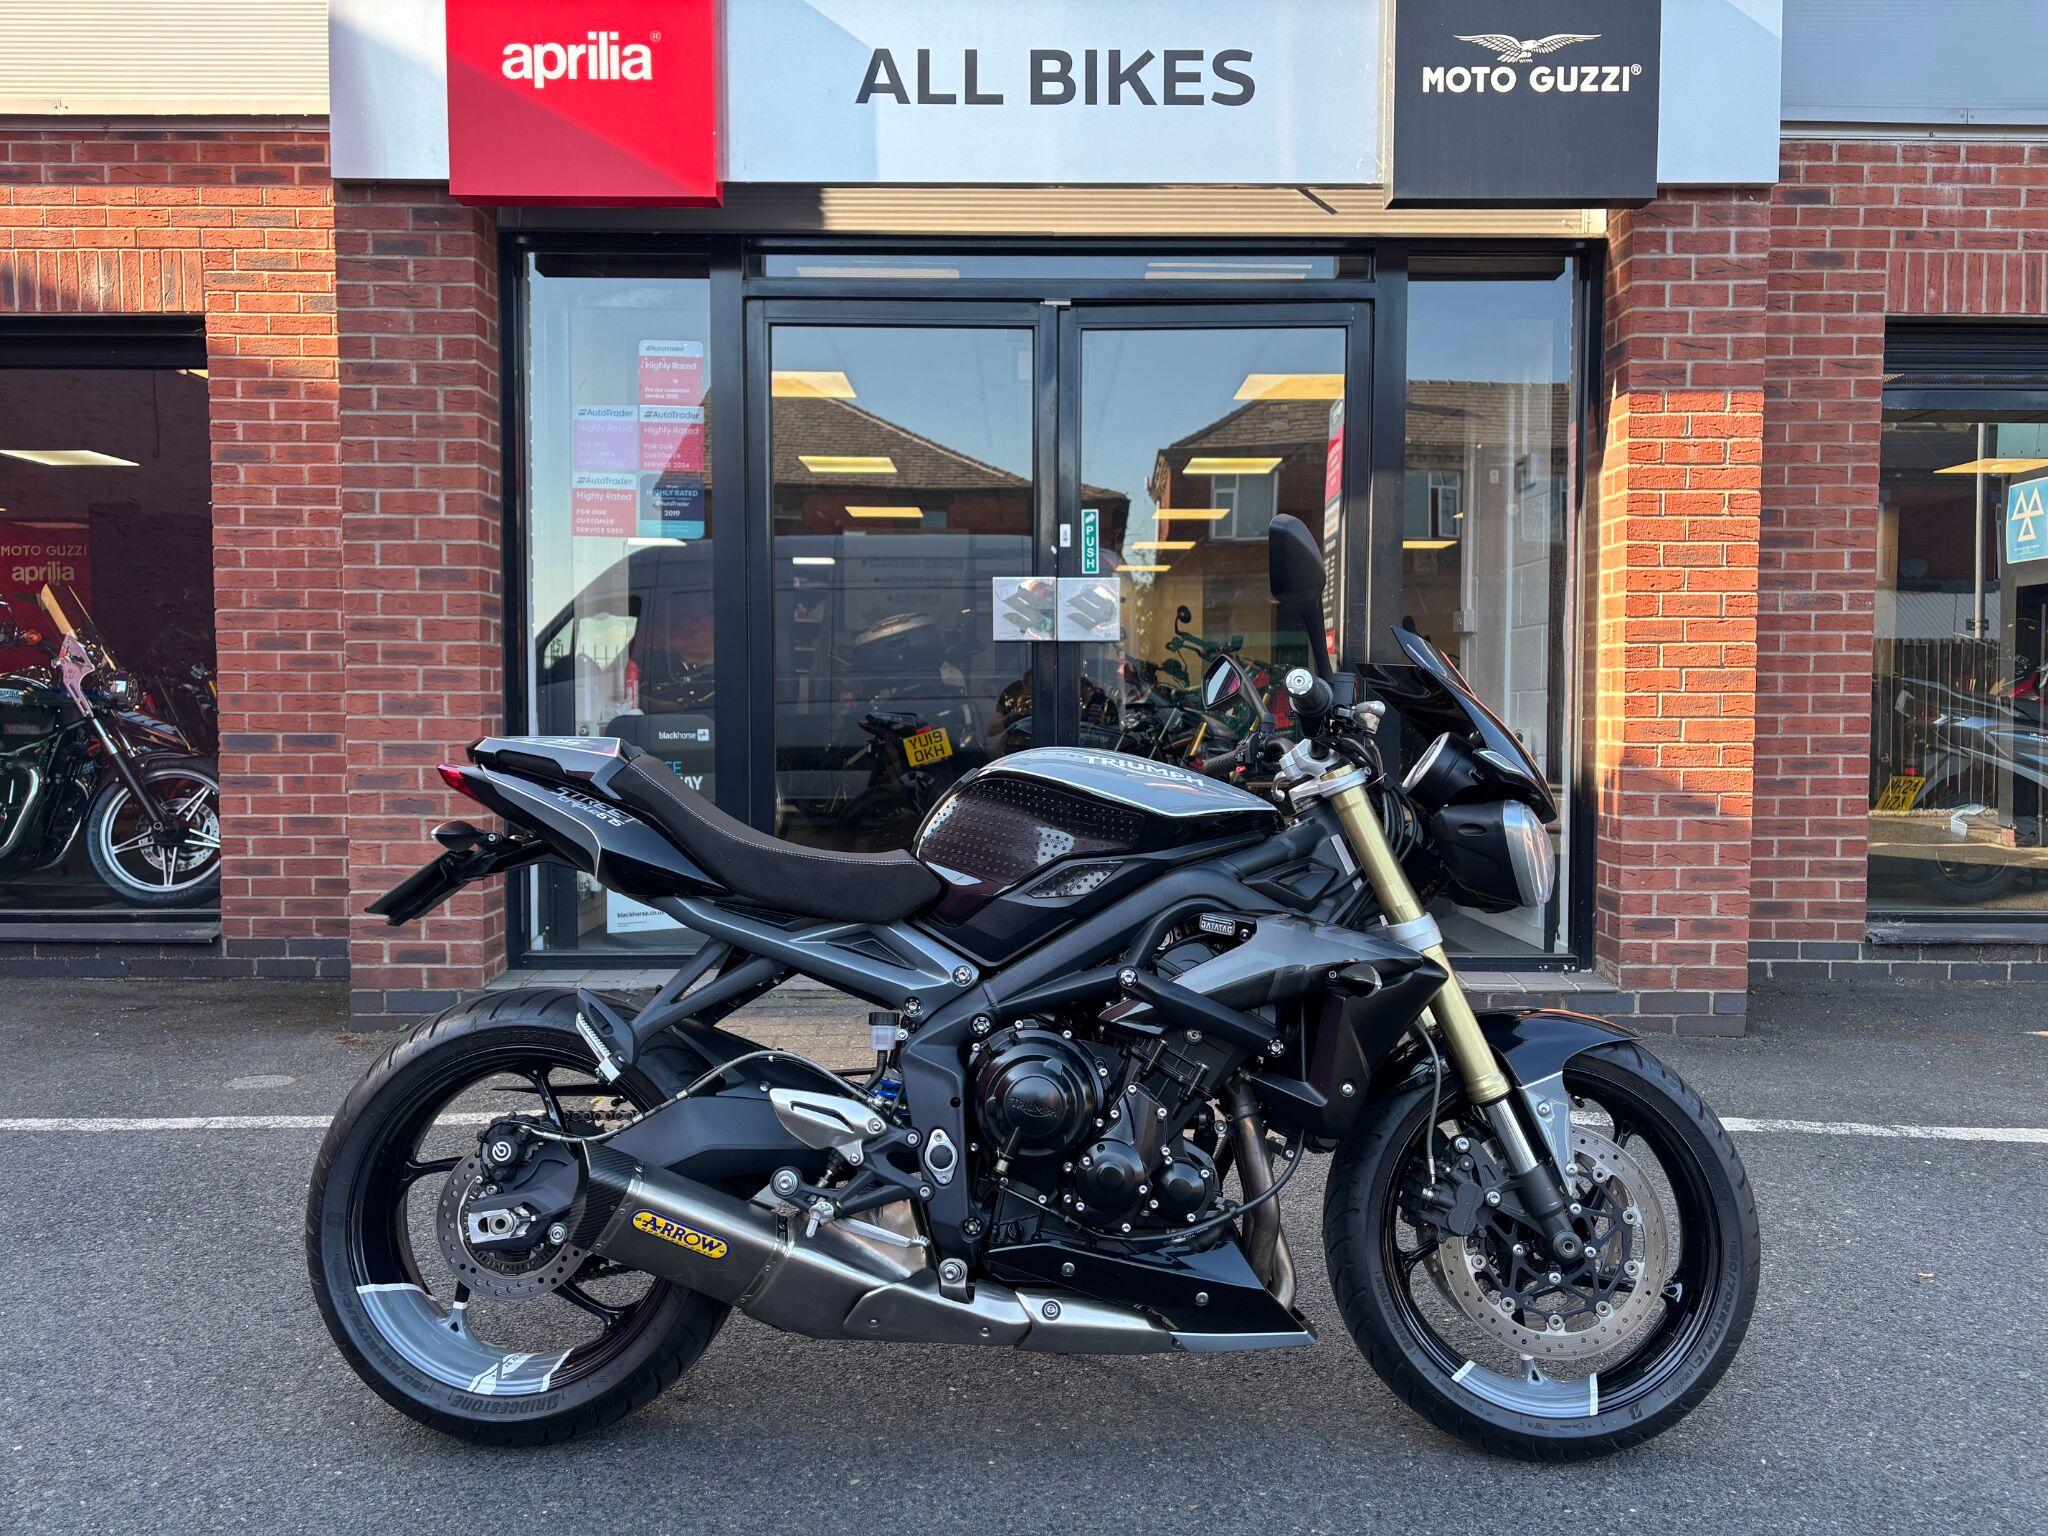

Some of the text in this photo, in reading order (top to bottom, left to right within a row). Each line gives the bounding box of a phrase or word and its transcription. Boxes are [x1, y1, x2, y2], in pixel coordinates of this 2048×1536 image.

[855, 48, 1256, 106] ALL BIKES
[1422, 66, 1517, 93] MOTO
[645, 361, 697, 371] Highly Rated
[586, 409, 633, 417] AutoTrader
[652, 411, 699, 420] AutoTrader
[643, 426, 699, 436] Highly Rated
[585, 476, 632, 485] AutoTrader
[576, 491, 632, 501] Highly Rated
[646, 489, 673, 497] HIGHLY
[0, 545, 87, 556] MOTO GUZZI
[1086, 526, 1095, 569] PUSH
[11, 561, 75, 585] aprilia
[658, 731, 696, 739] blackhorse
[908, 731, 944, 750] YU19
[1083, 755, 1204, 788] TRIUMPH
[550, 786, 643, 824] STREET
[641, 1216, 723, 1252] ARROW
